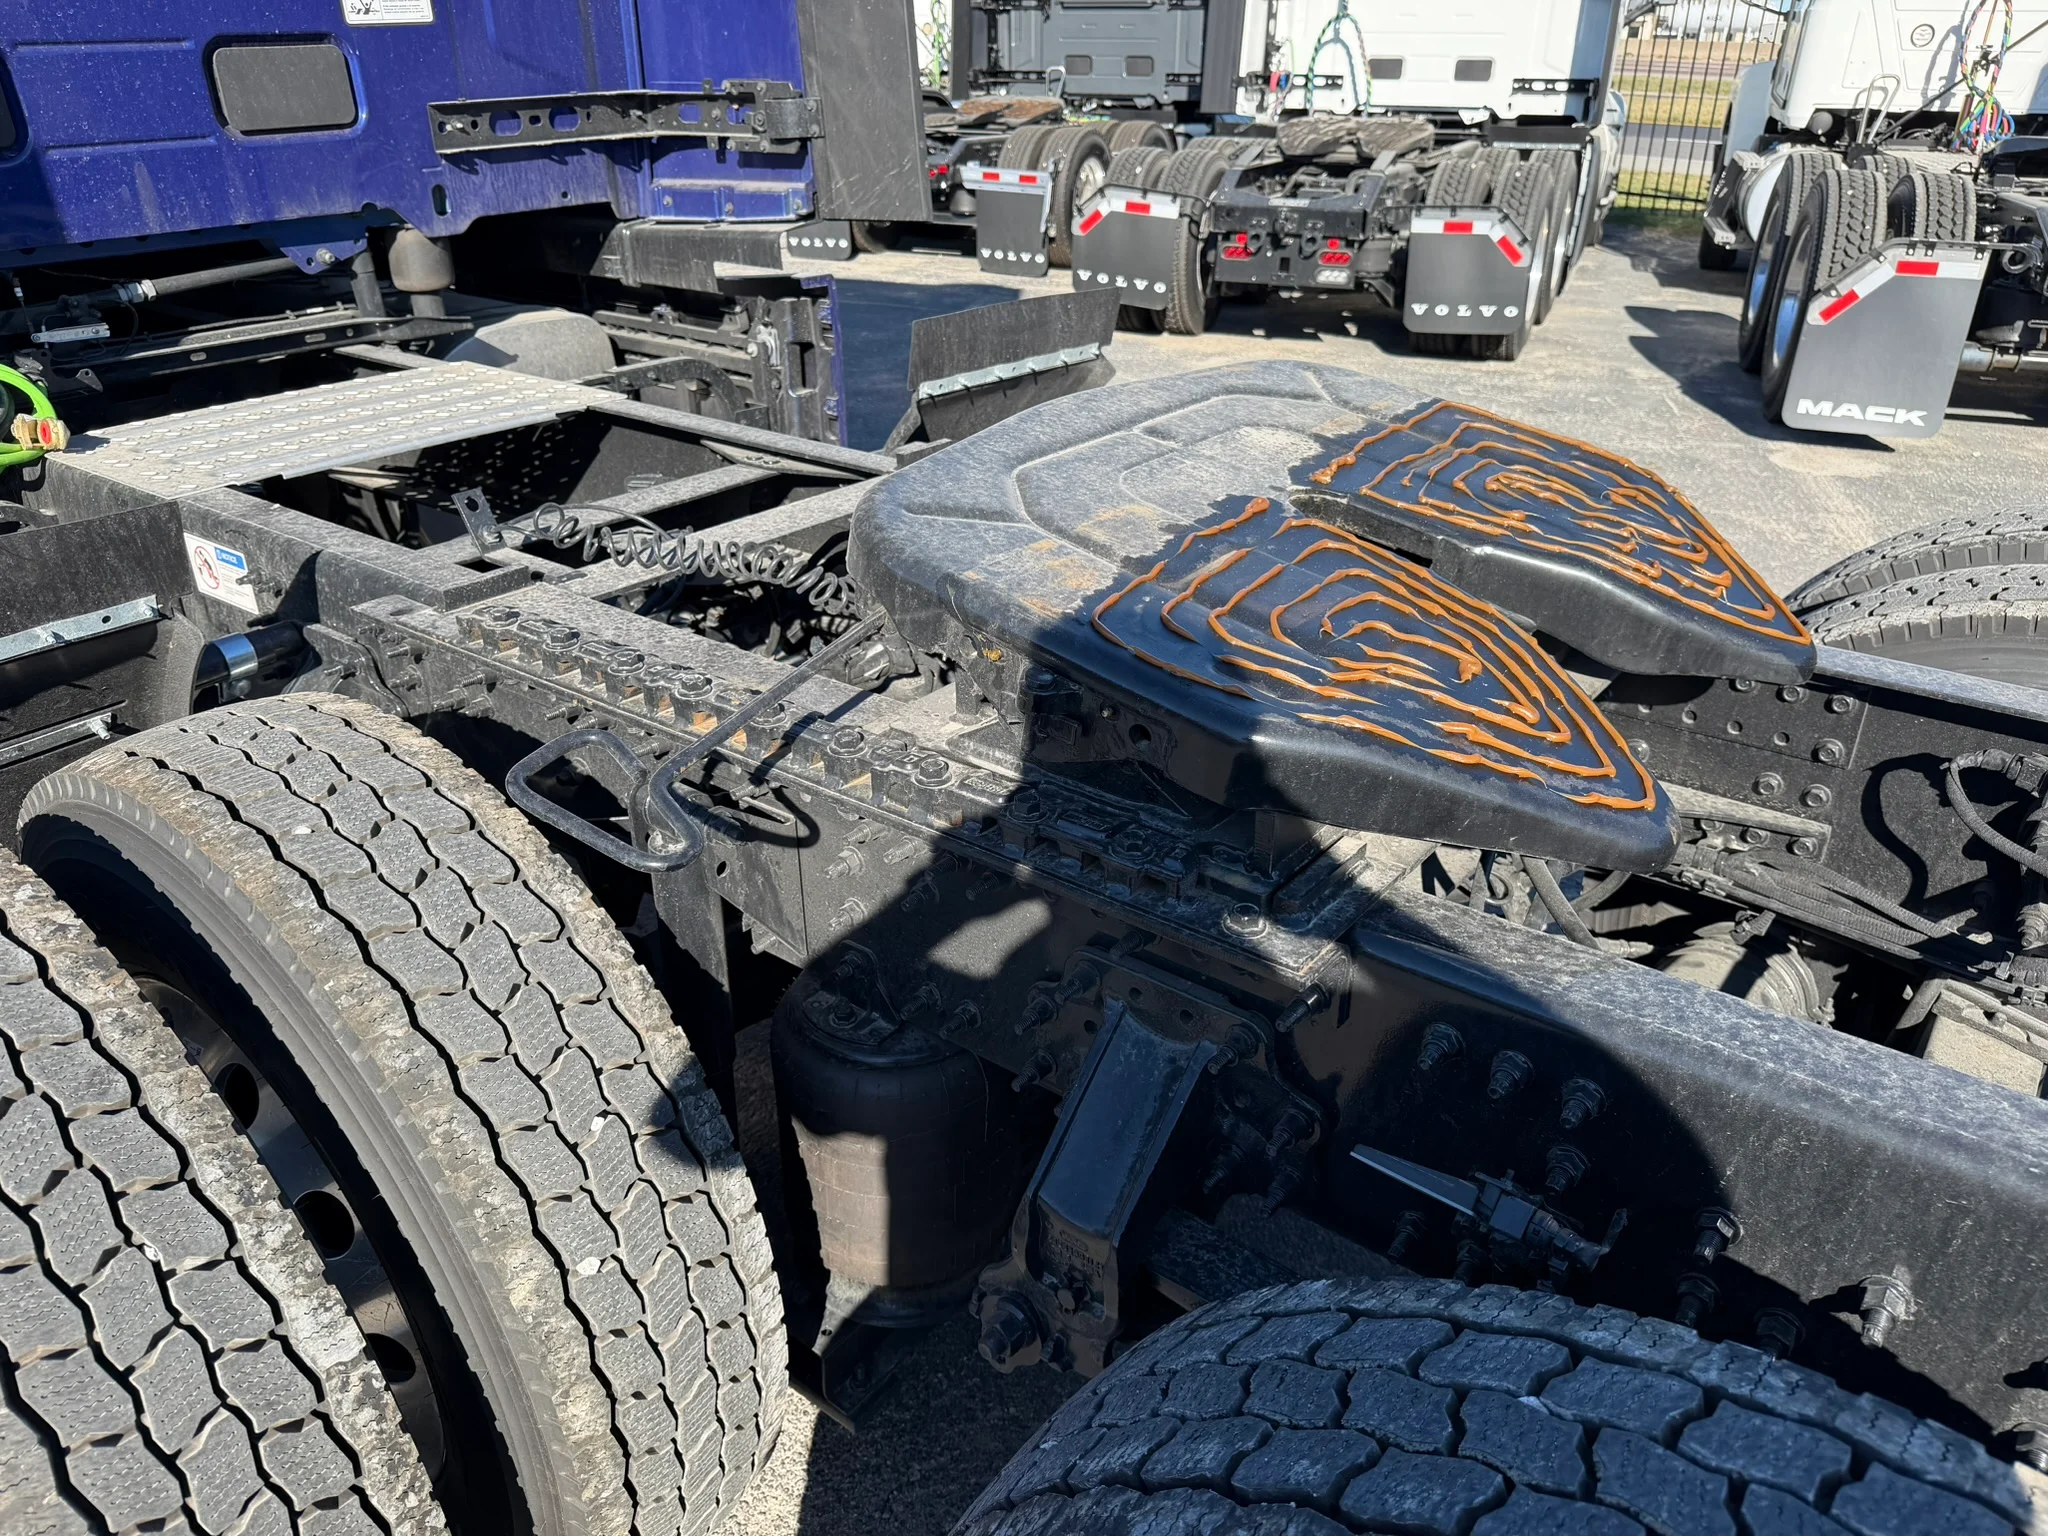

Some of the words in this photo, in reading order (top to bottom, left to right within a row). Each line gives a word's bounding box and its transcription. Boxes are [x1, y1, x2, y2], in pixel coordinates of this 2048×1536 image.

[788, 236, 849, 248] VOLVO
[980, 247, 1046, 264] VOLVO
[1076, 268, 1167, 294] VOLVO
[1410, 302, 1520, 318] VOLVO
[1796, 398, 1928, 427] MACK
